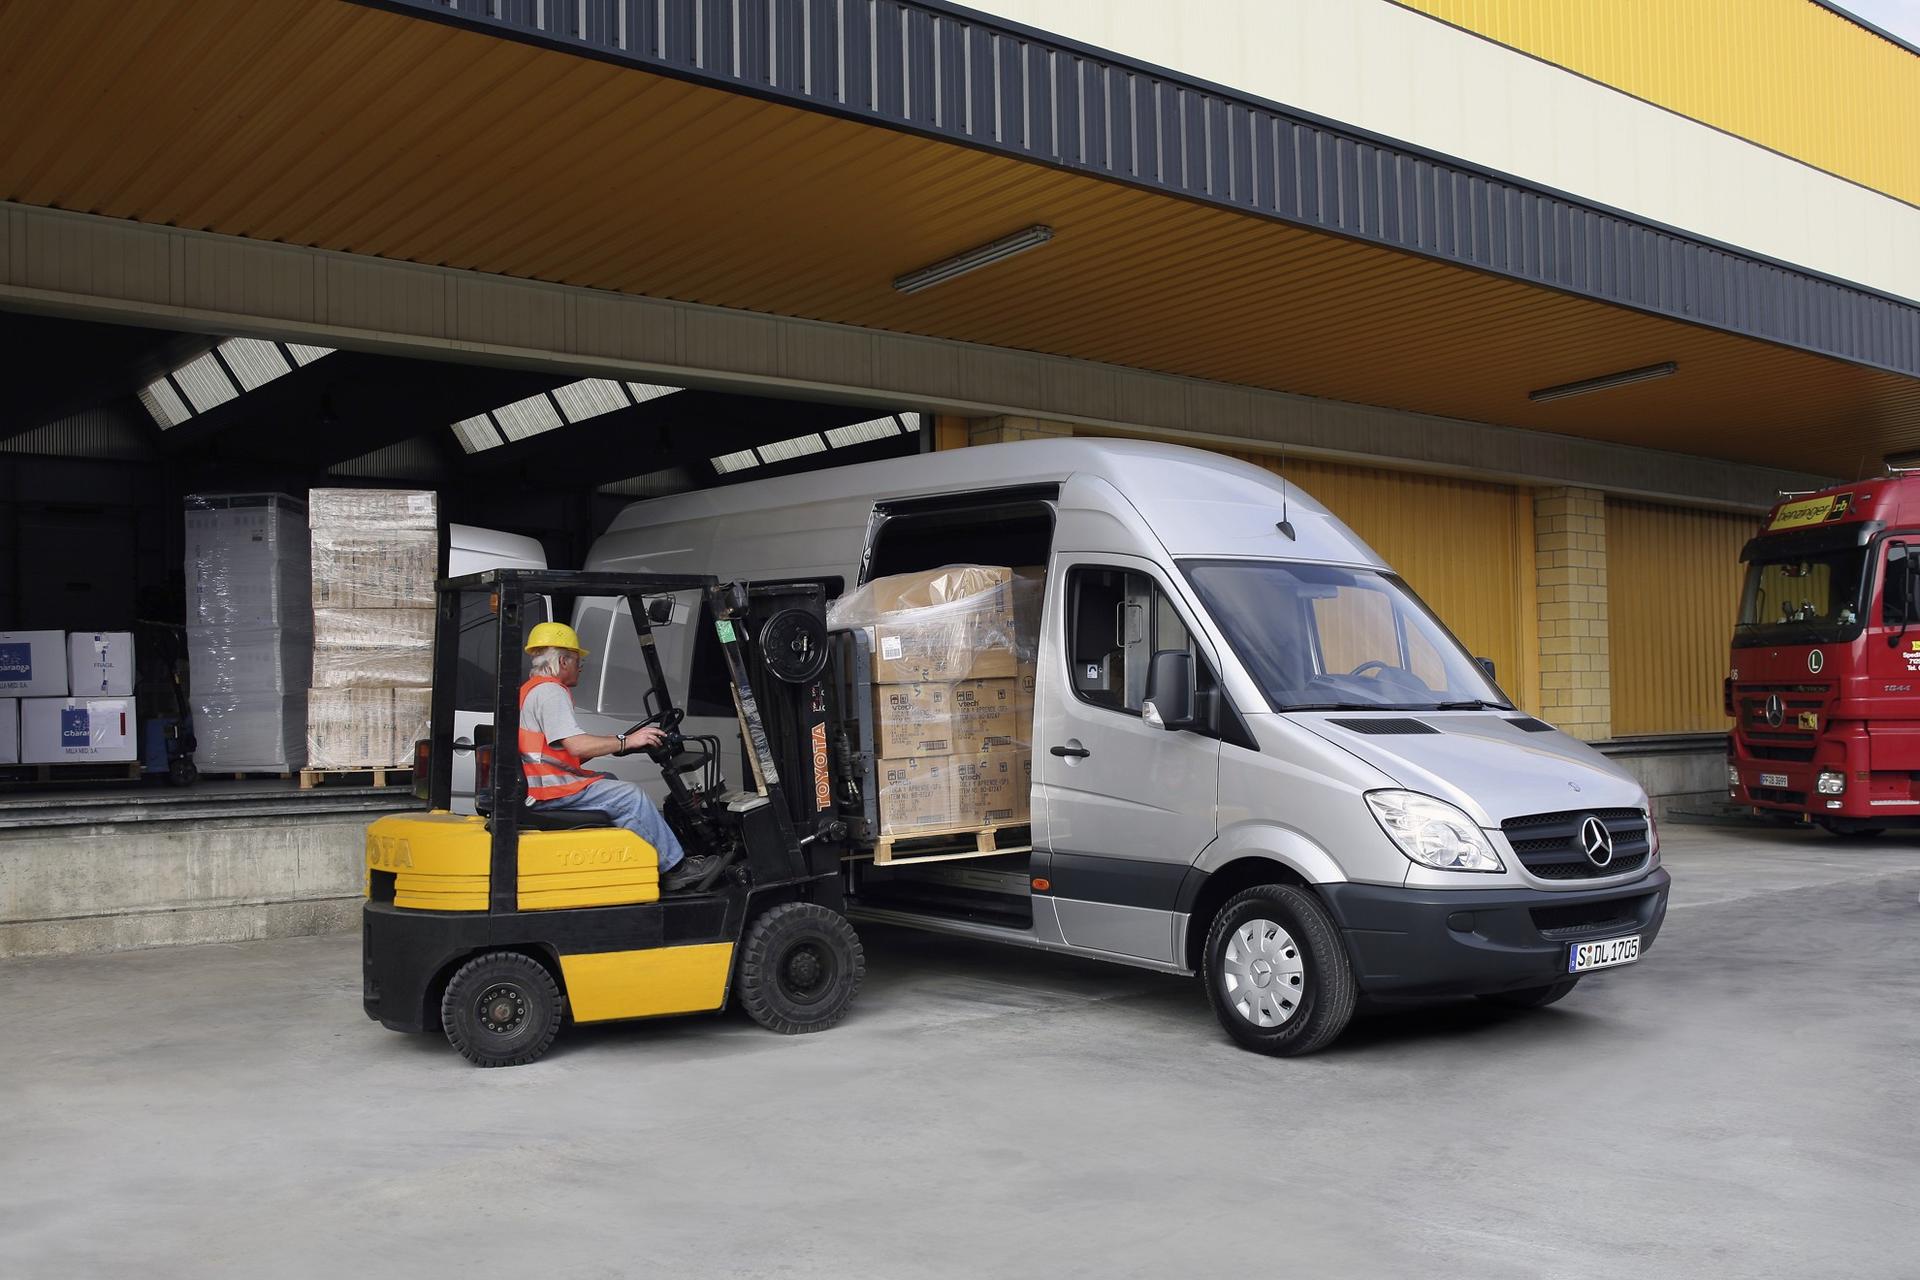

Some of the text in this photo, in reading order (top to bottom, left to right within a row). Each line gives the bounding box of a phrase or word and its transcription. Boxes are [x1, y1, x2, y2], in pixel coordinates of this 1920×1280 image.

[1777, 504, 1830, 522] benzinger
[1812, 654, 1819, 669] L
[812, 721, 831, 812] TOYOTA
[556, 846, 639, 867] TOYOTA
[1578, 939, 1638, 966] S DL 1705
